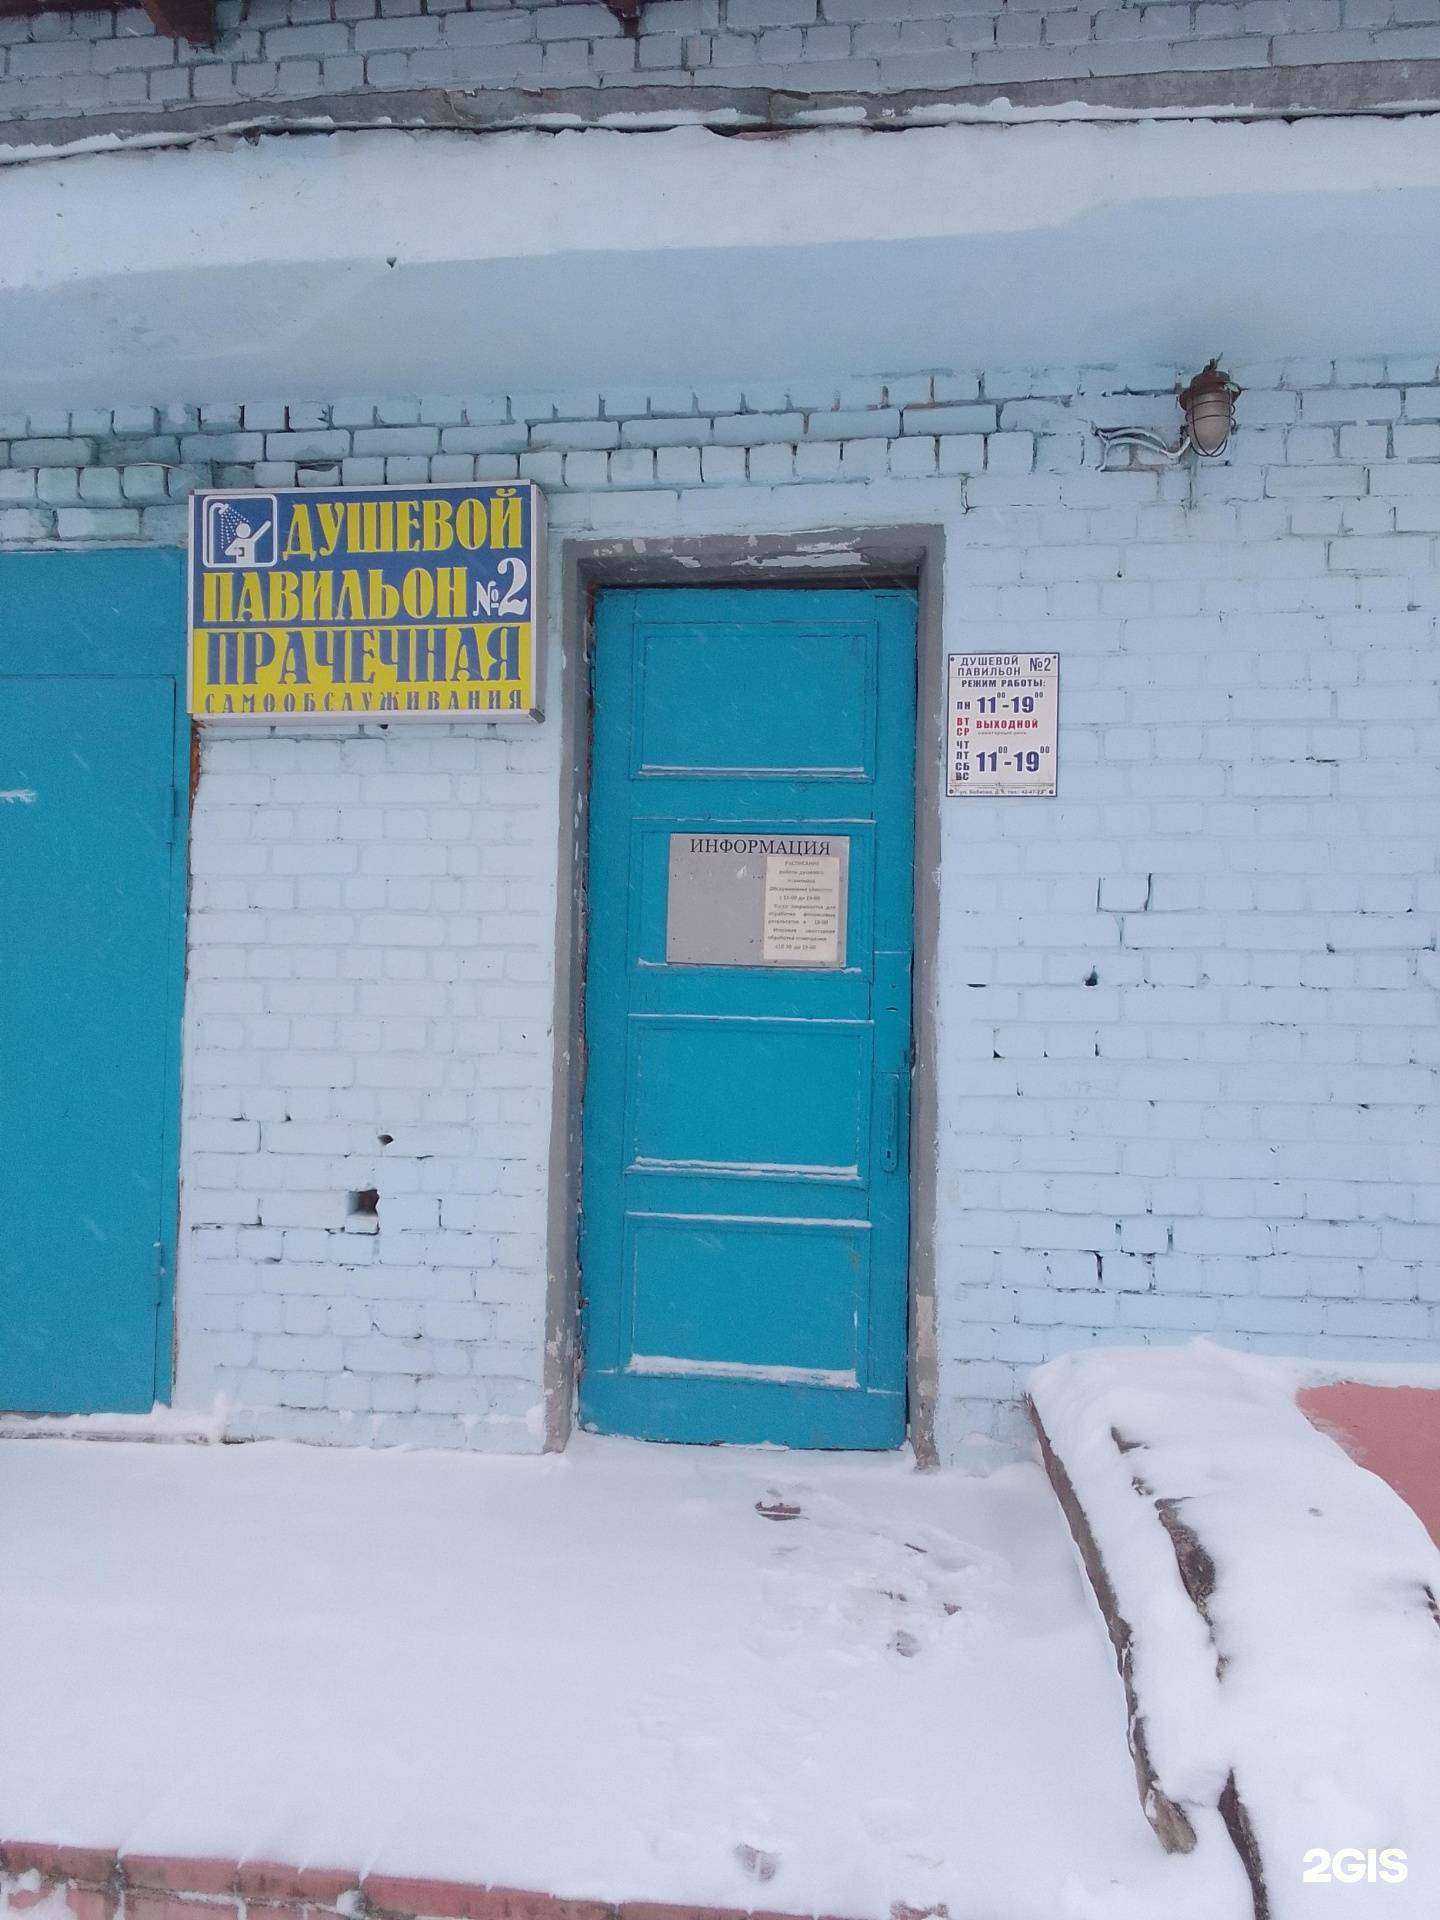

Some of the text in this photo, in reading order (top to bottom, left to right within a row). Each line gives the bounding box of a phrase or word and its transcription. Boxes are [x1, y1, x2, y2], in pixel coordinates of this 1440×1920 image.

[282, 487, 523, 561] ДУШЕВОЙ
[203, 557, 528, 622] ПАВИЛЬОН №2
[206, 625, 521, 685] ПРАЧЕЧНАЯ
[960, 655, 1051, 672] ДУШЕВОЙ №2
[957, 667, 1021, 677] ПАВИЛЬОН
[961, 679, 1046, 688] РЕЖИМ РАБОТЫ:
[205, 689, 523, 713] САМООБСЛУЖИВАНИЯ
[956, 701, 971, 710] ПН
[956, 717, 1038, 730] ВТ ВЫХОДНОЙ
[956, 728, 970, 736] СР
[956, 740, 970, 749] ЧТ
[956, 751, 970, 760] ПТ
[955, 762, 970, 771] СБ
[955, 772, 970, 781] ВС
[690, 838, 832, 856] ИНФОРМАЦИЯ
